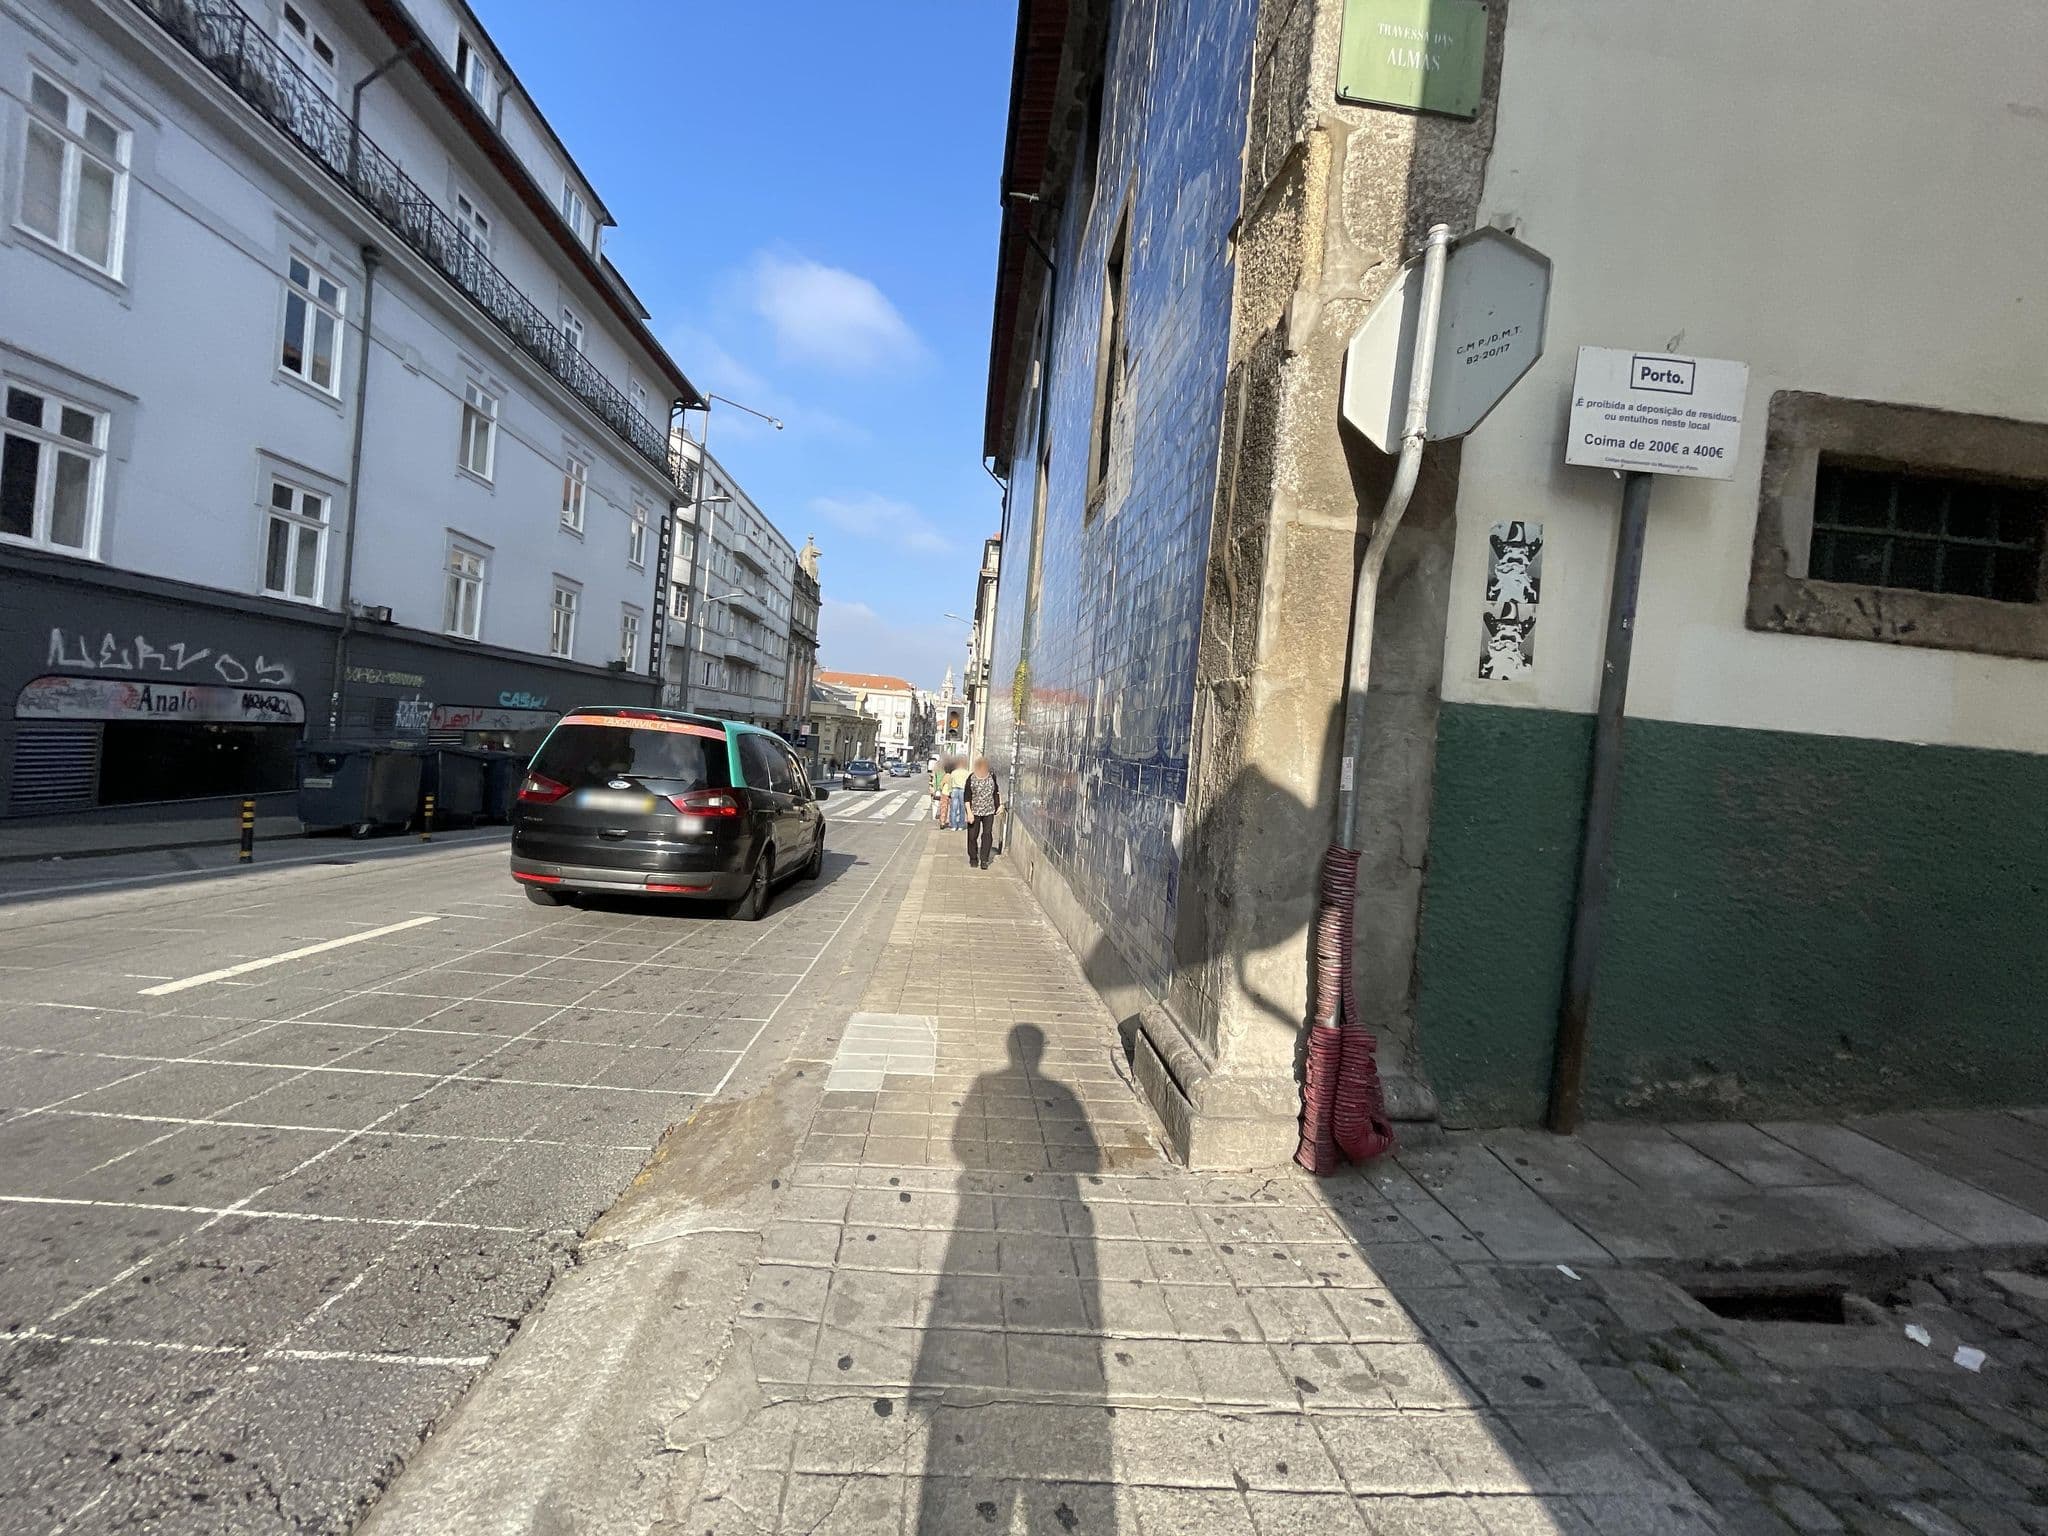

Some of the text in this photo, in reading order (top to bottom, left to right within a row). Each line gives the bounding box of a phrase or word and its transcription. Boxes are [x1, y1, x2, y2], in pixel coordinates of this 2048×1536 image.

[1377, 23, 1454, 47] TRAVESSA DAS
[1386, 47, 1440, 71] ALMAS
[1640, 366, 1684, 384] Porto.
[1586, 399, 1626, 411] proibida
[1636, 403, 1683, 417] deposição
[1686, 409, 1697, 418] de
[1604, 413, 1711, 431] ou entulhos neste local
[1584, 433, 1724, 459] Coima de 200€ a 400€
